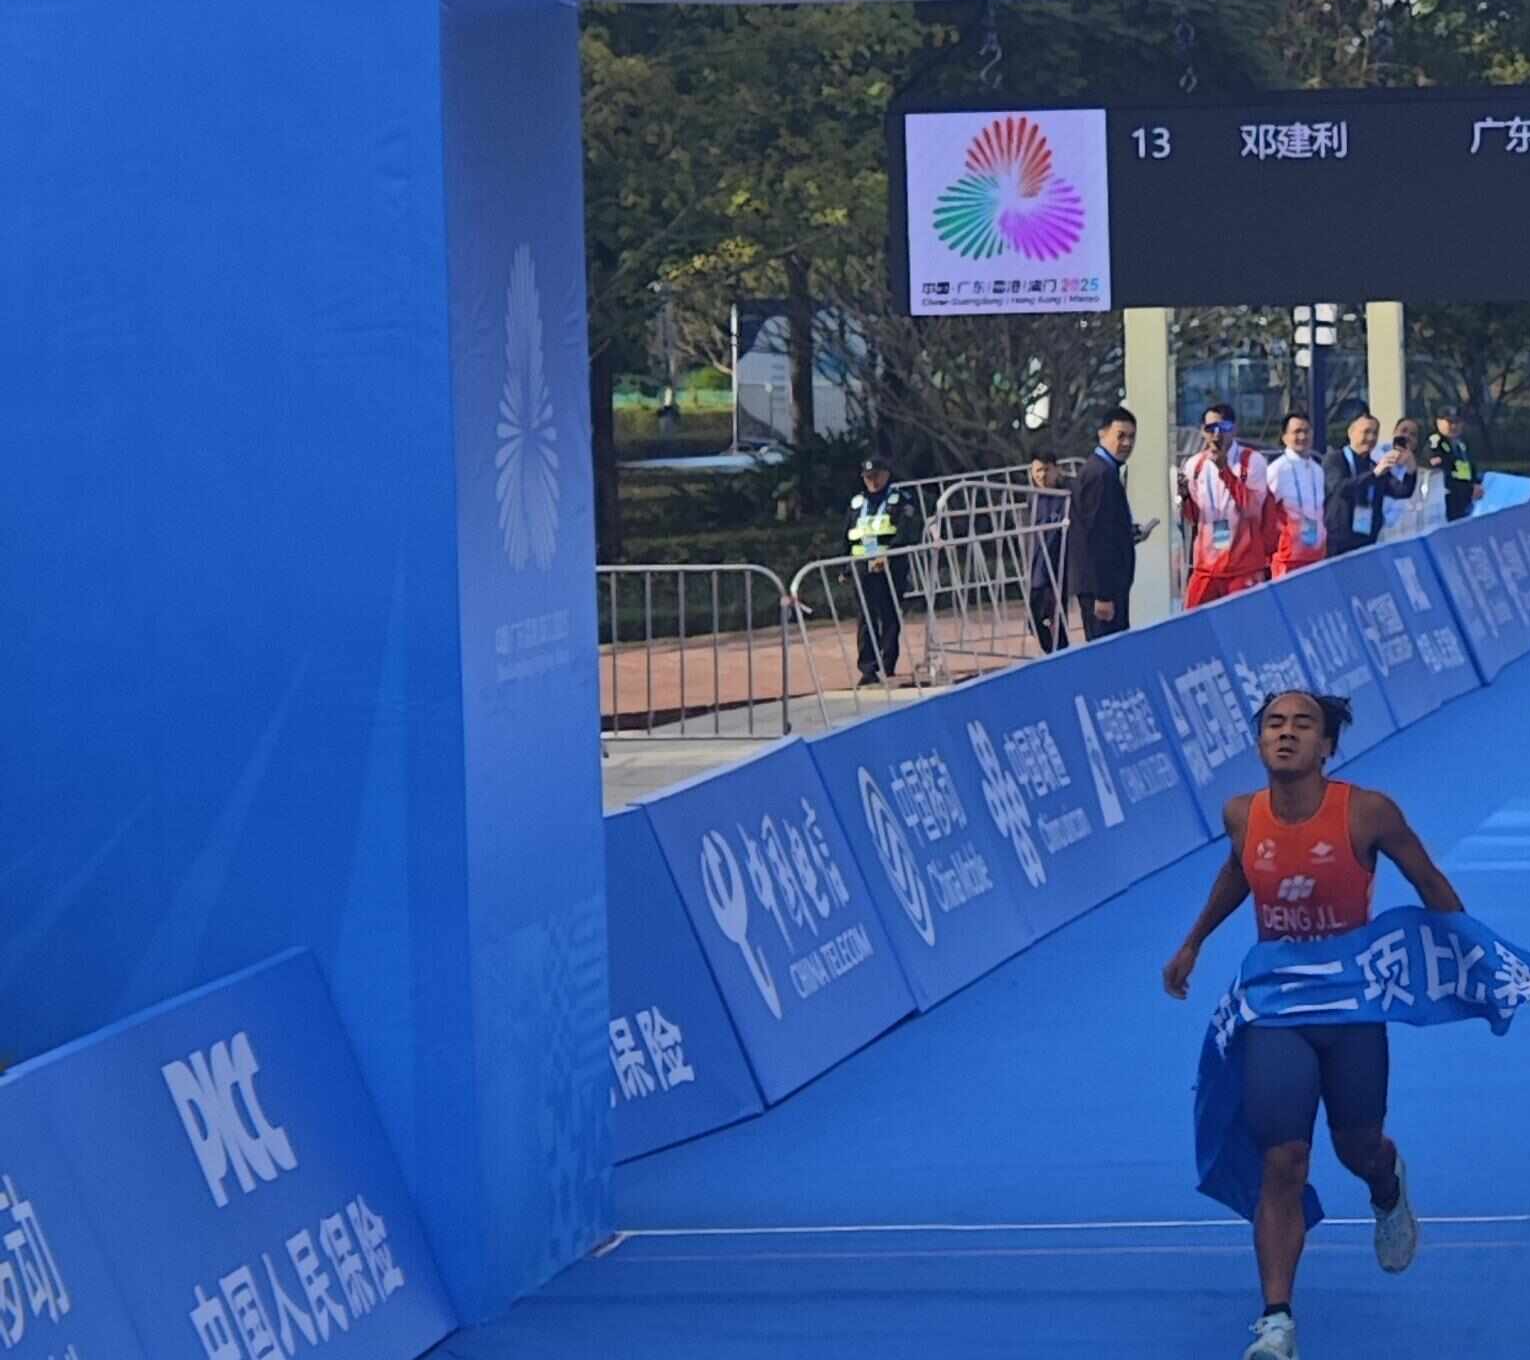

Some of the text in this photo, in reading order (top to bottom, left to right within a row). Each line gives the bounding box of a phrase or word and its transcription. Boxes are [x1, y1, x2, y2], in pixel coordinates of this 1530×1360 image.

[1131, 127, 1171, 159] 13
[1239, 121, 1348, 160] 邓建利
[1061, 277, 1100, 292] 2025
[888, 747, 968, 849] 中国移动
[736, 796, 851, 956] 中国电信
[1262, 904, 1313, 931] DENG
[608, 1006, 695, 1108] 保险
[161, 1031, 297, 1208] PICC
